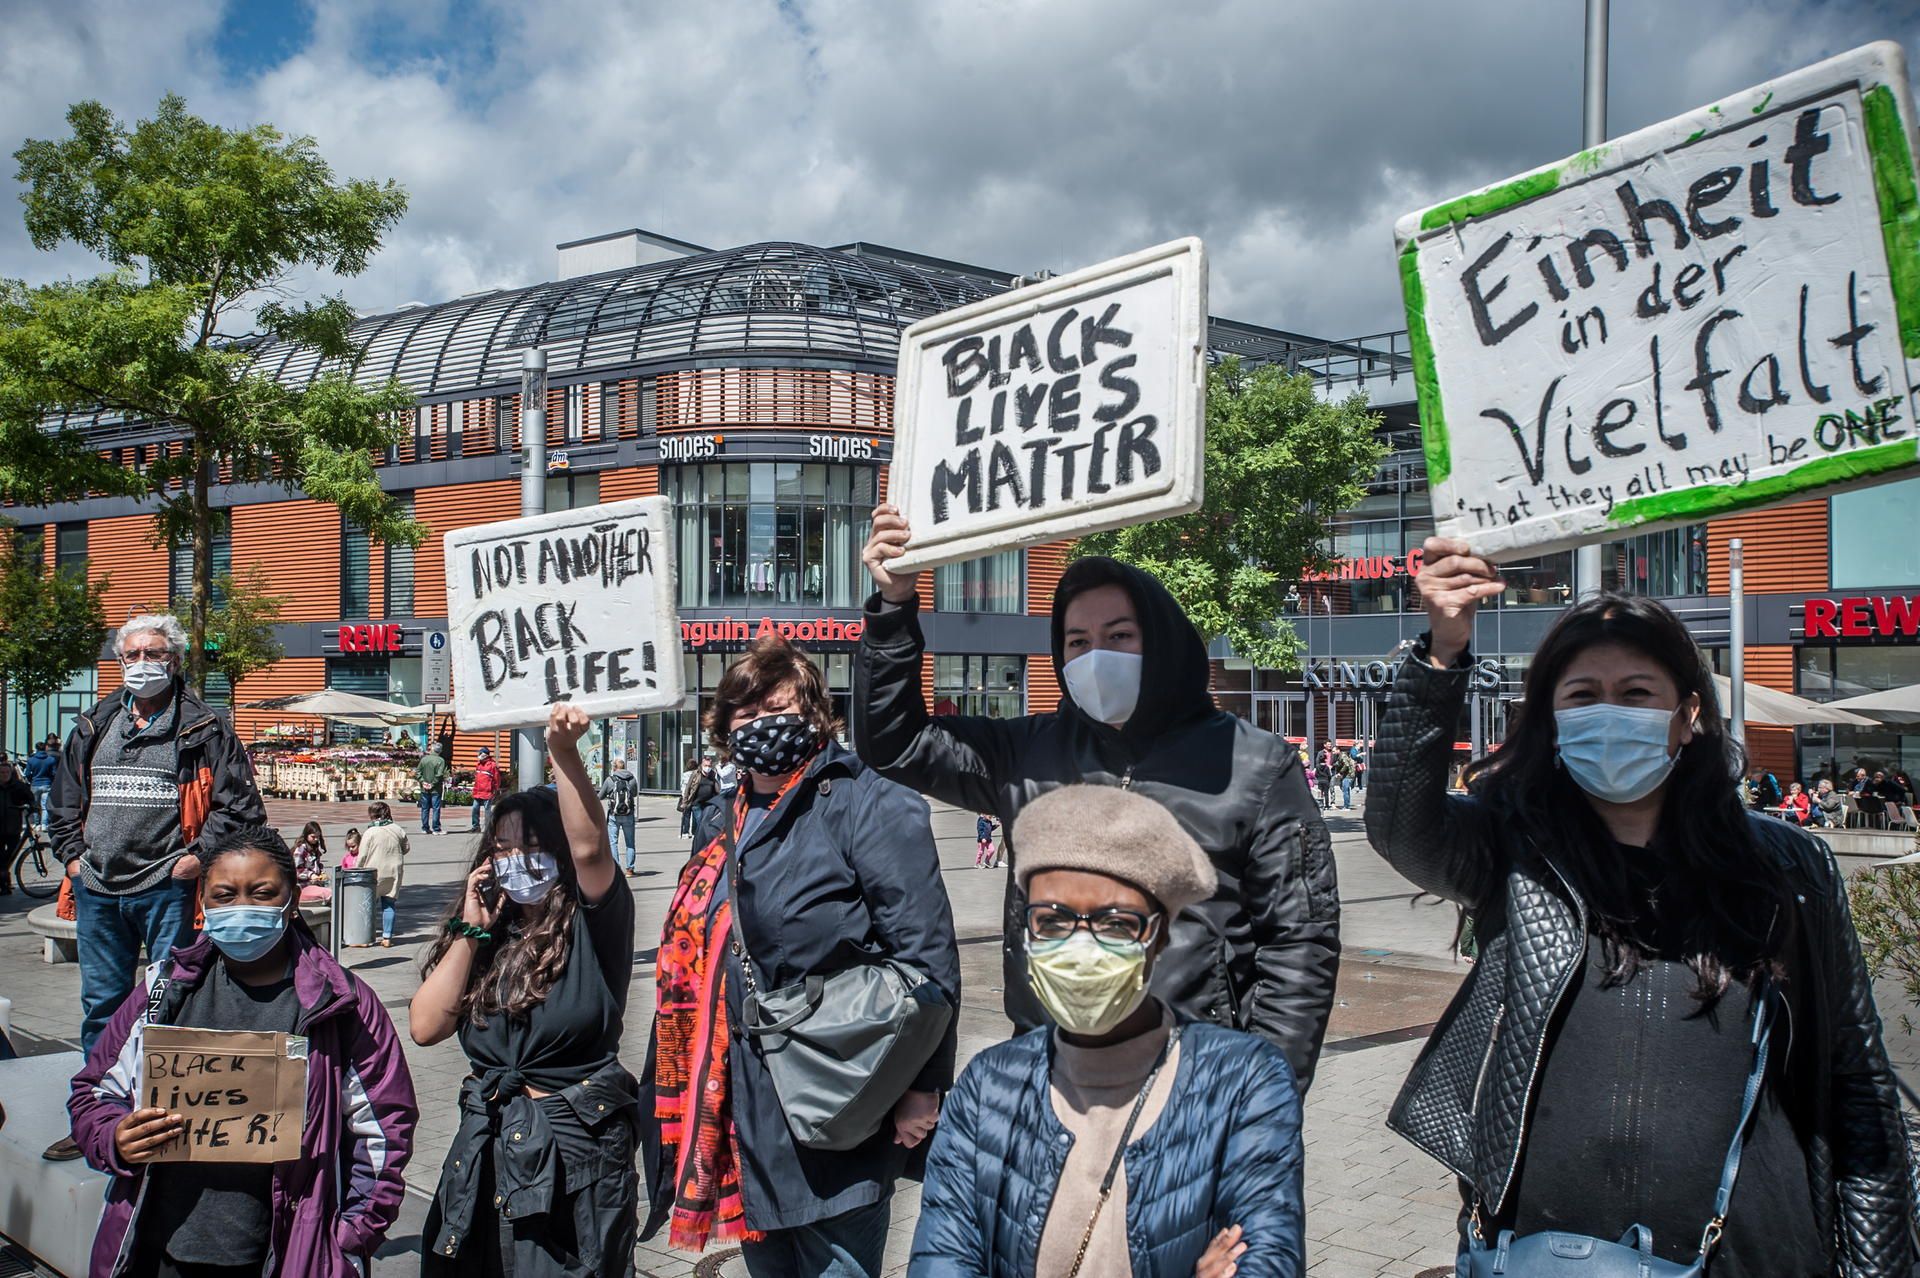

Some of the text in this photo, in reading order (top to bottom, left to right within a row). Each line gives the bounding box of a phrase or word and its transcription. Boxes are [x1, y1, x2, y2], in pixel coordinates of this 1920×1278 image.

[1461, 109, 1843, 346] Einheit
[1560, 244, 1747, 354] in der
[942, 303, 1133, 398] BLACK
[1480, 270, 1886, 487] Vielfalt
[956, 354, 1140, 446] LIVES
[660, 434, 715, 463] snipes
[809, 434, 872, 463] snipes
[931, 415, 1161, 525] MATTER
[1546, 484, 1614, 516] they
[1626, 462, 1672, 497] all
[1686, 453, 1750, 483] may
[1768, 434, 1808, 466] be
[1814, 395, 1906, 452] ONE
[471, 523, 654, 600] NOT ANOTHER
[339, 623, 402, 652] REWE
[470, 600, 588, 692] BLACK
[755, 616, 867, 641] Apothe
[1804, 595, 1920, 637] REW
[543, 640, 657, 706] LIFE!
[146, 1054, 246, 1080] BLACK
